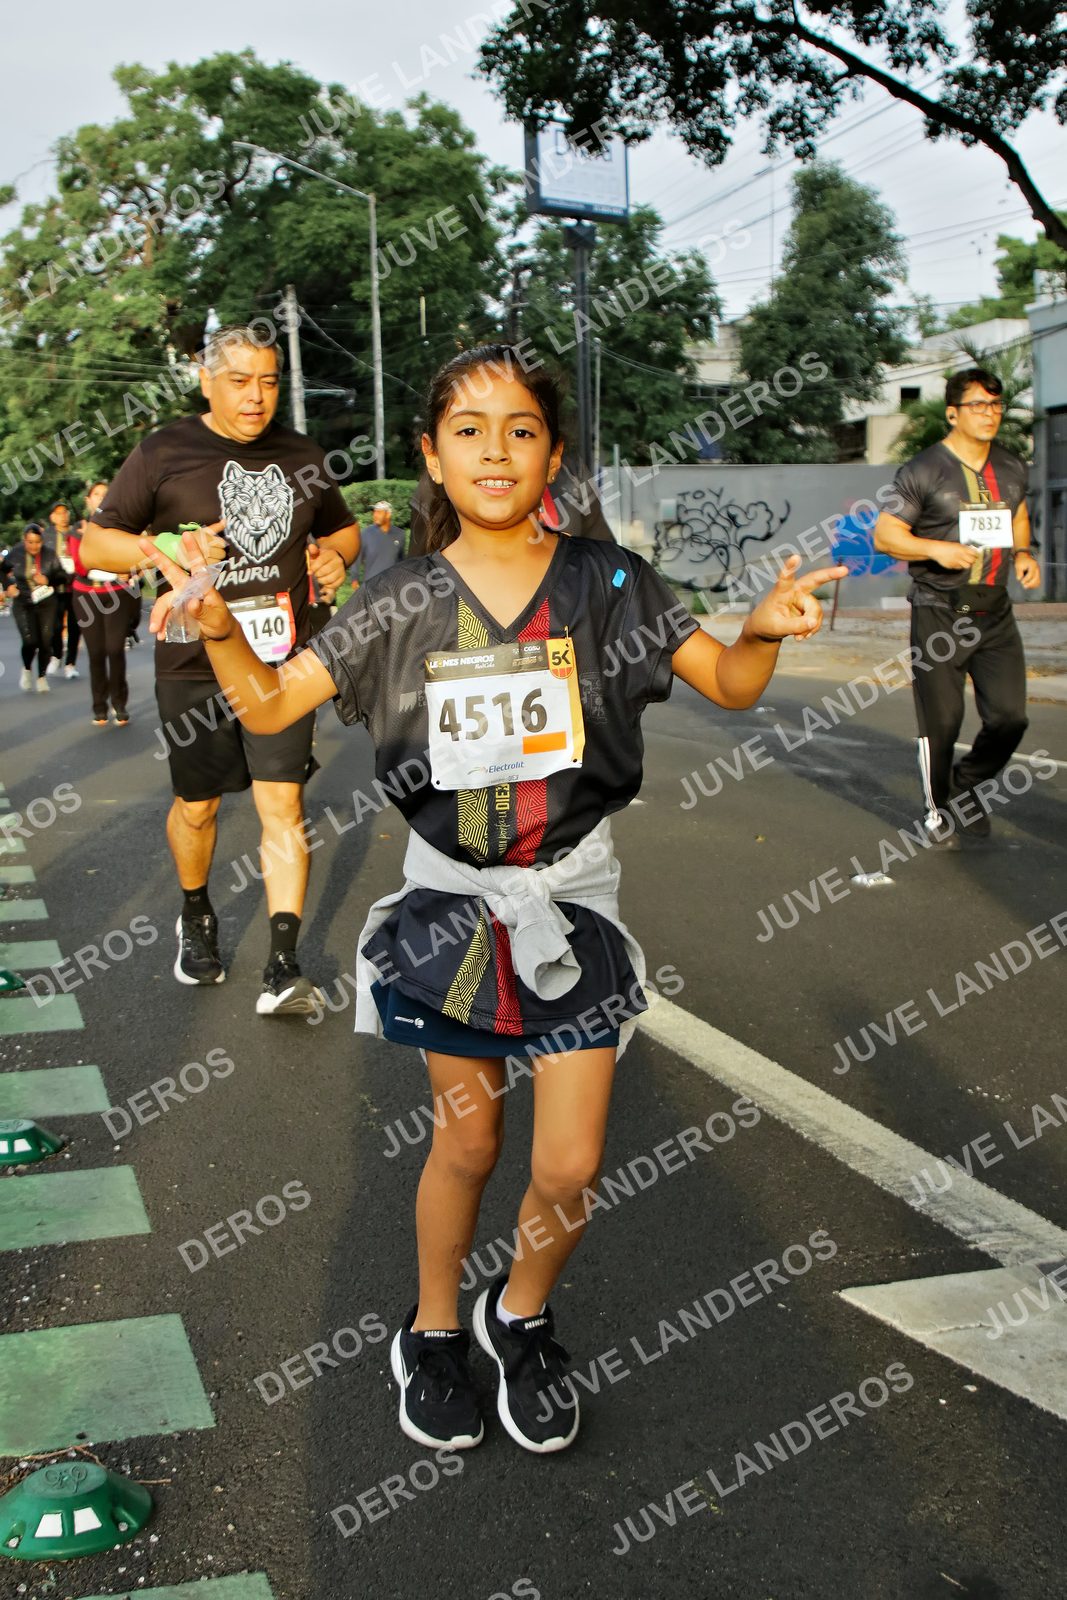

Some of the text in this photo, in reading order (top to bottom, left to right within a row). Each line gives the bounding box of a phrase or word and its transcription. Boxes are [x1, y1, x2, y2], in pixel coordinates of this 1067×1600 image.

[677, 487, 724, 506] TOY
[970, 516, 1003, 531] 7832
[228, 556, 249, 570] LA
[240, 615, 286, 640] 140
[460, 654, 495, 666] NEGROS
[551, 649, 571, 666] 5K
[439, 687, 547, 741] 4516
[488, 761, 524, 774] Electrolit
